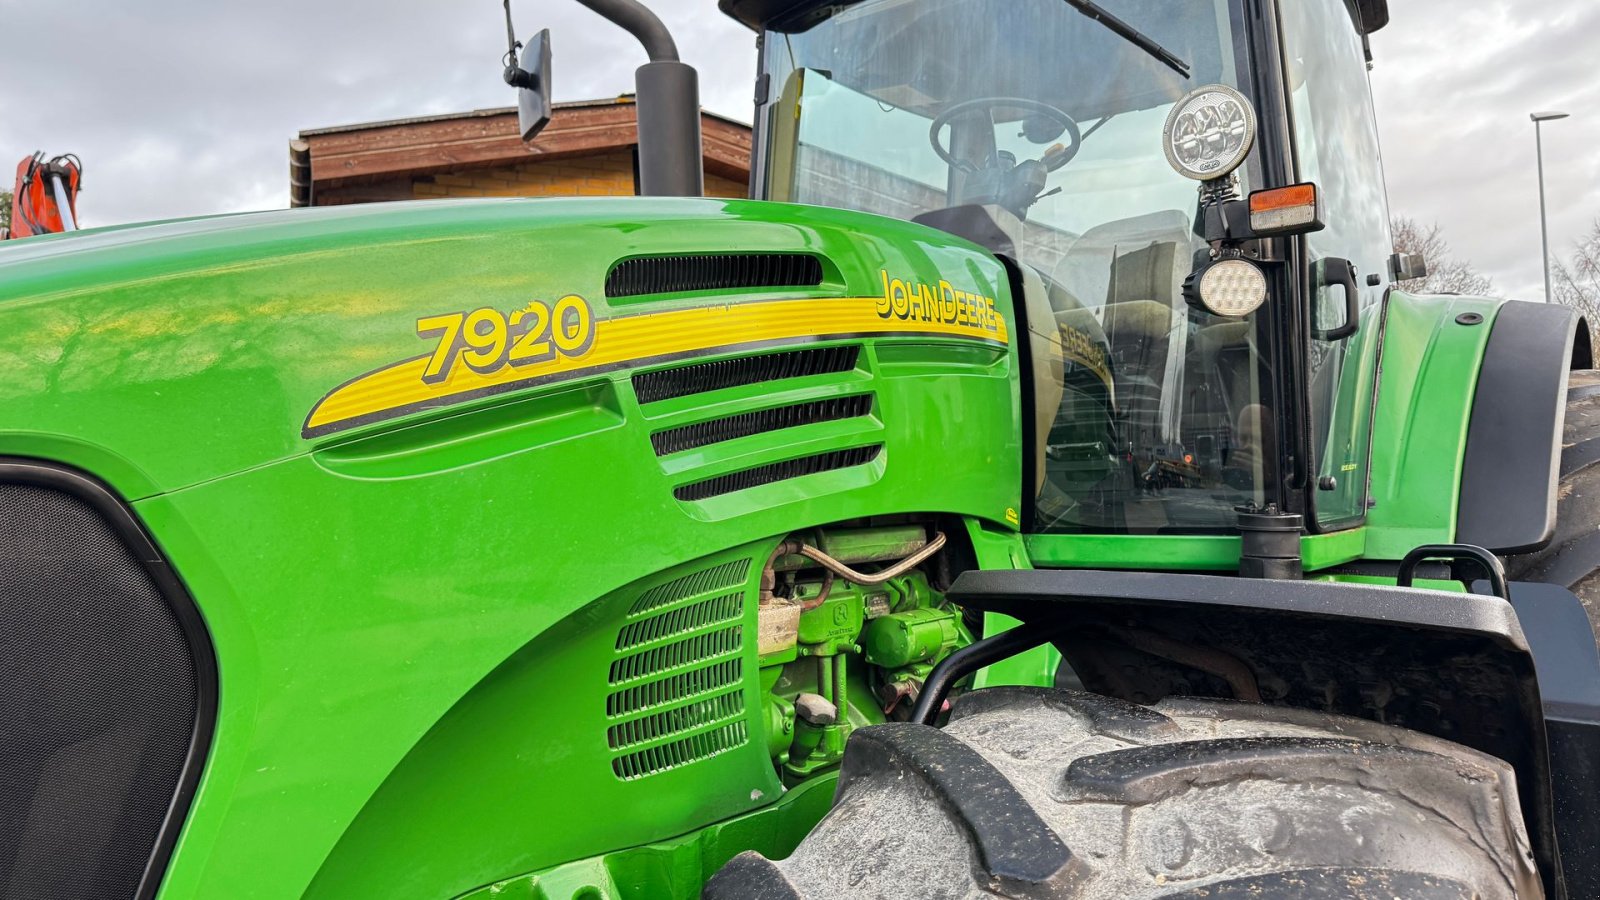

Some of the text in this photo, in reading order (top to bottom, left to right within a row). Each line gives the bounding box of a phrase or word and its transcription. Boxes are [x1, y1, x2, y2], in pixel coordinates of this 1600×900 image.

[876, 269, 997, 331] JOHN DEERE
[417, 294, 594, 384] 7920
